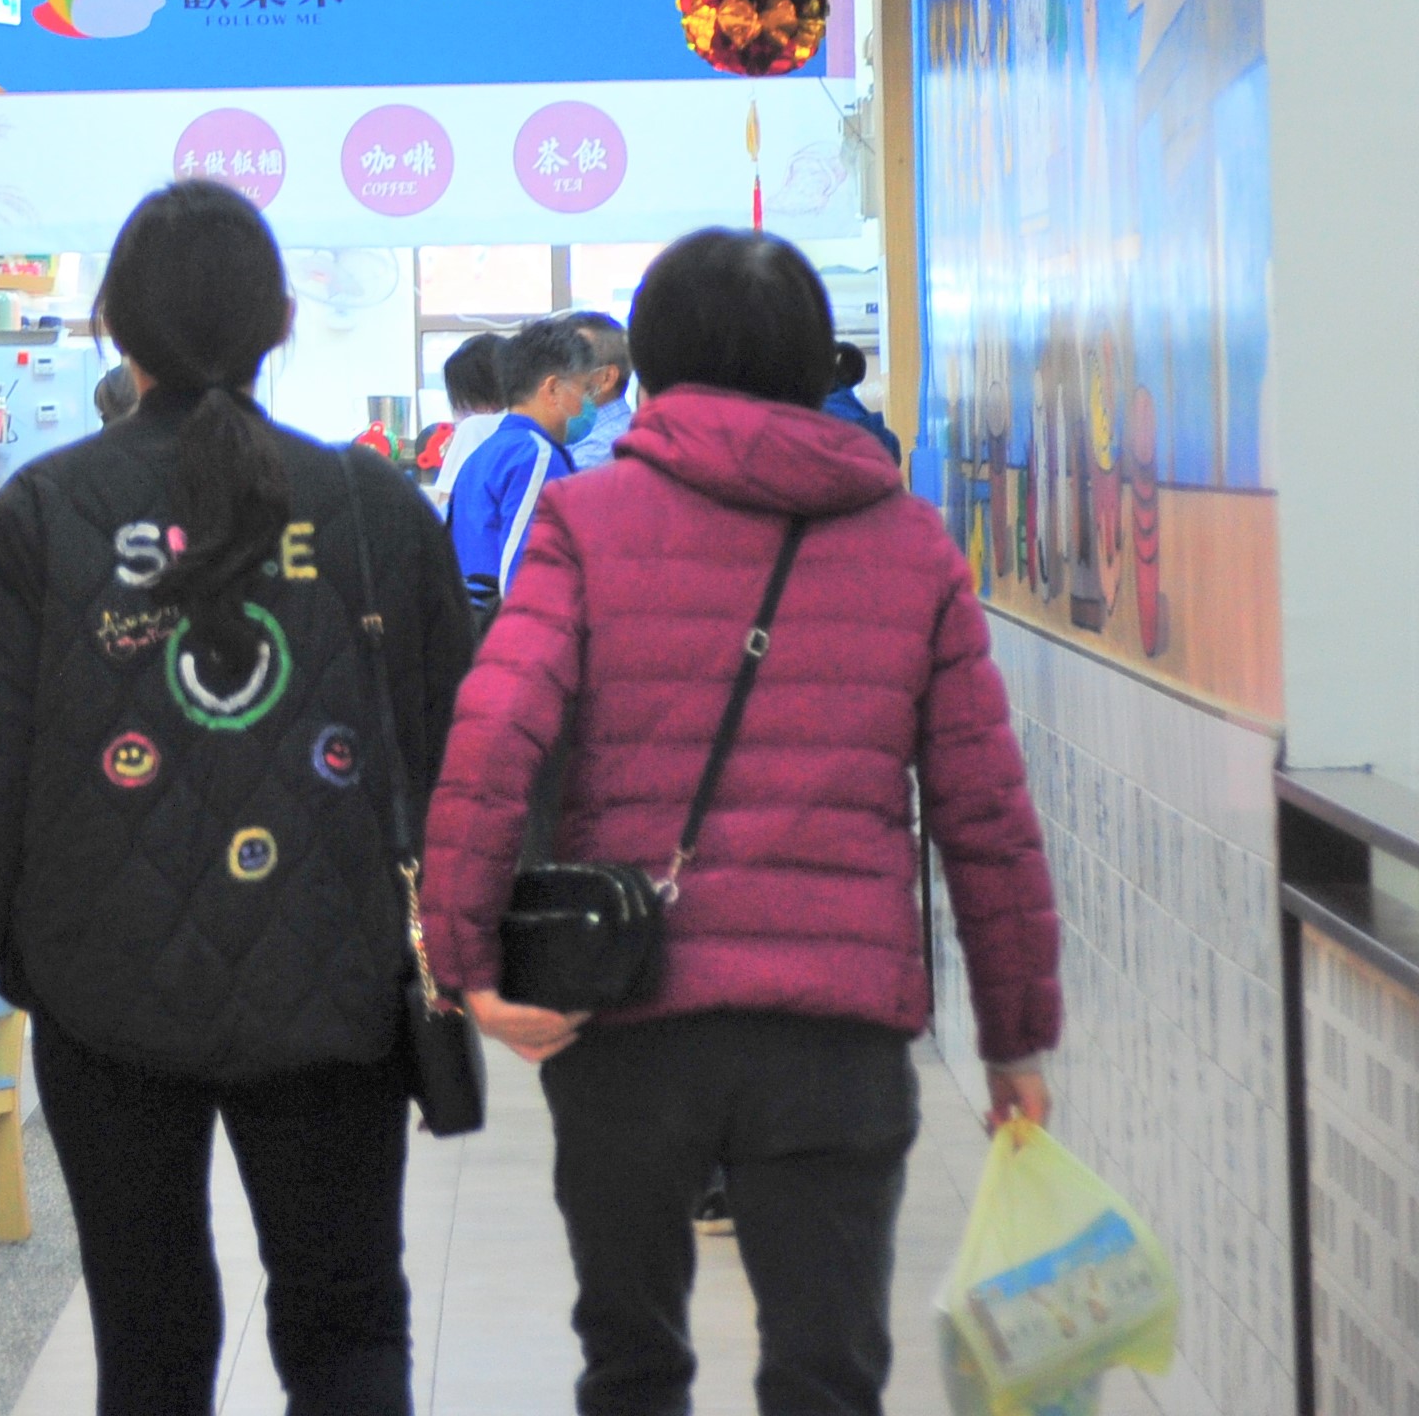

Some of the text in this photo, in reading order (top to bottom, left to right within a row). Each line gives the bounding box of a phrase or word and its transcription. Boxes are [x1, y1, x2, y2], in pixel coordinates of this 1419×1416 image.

[360, 139, 436, 178] 咖啡
[362, 180, 418, 197] COFFEE
[554, 177, 583, 193] TEA
